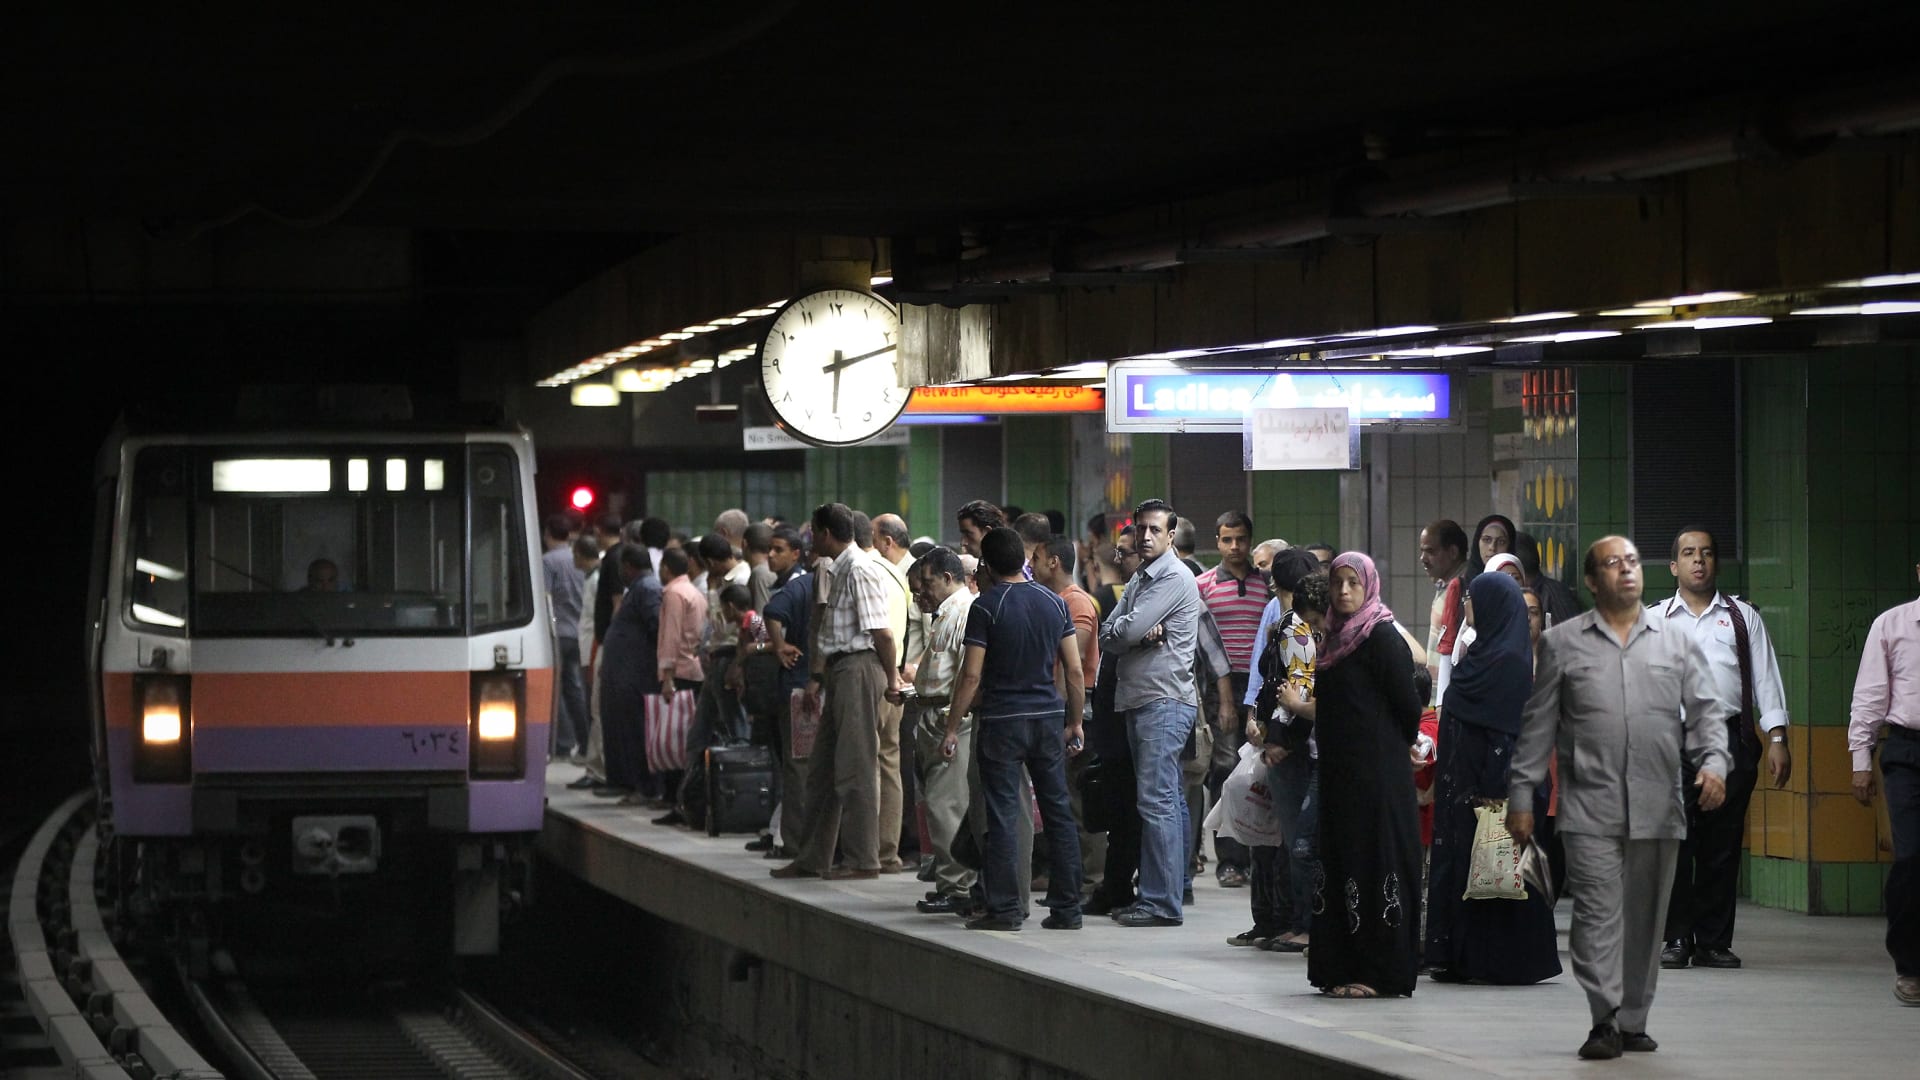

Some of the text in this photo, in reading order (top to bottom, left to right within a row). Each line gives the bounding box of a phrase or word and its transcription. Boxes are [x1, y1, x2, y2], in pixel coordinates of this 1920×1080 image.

[829, 302, 843, 317] ١٢
[802, 311, 813, 327] ١١
[782, 331, 796, 347] ١٠
[883, 331, 891, 345] ٢
[772, 358, 782, 374] ٩
[783, 391, 793, 402] ٨
[883, 387, 891, 403] ٤
[1134, 383, 1250, 411] Ladies
[805, 408, 814, 420] ٧
[863, 411, 873, 422] ٥
[834, 416, 842, 429] ٦
